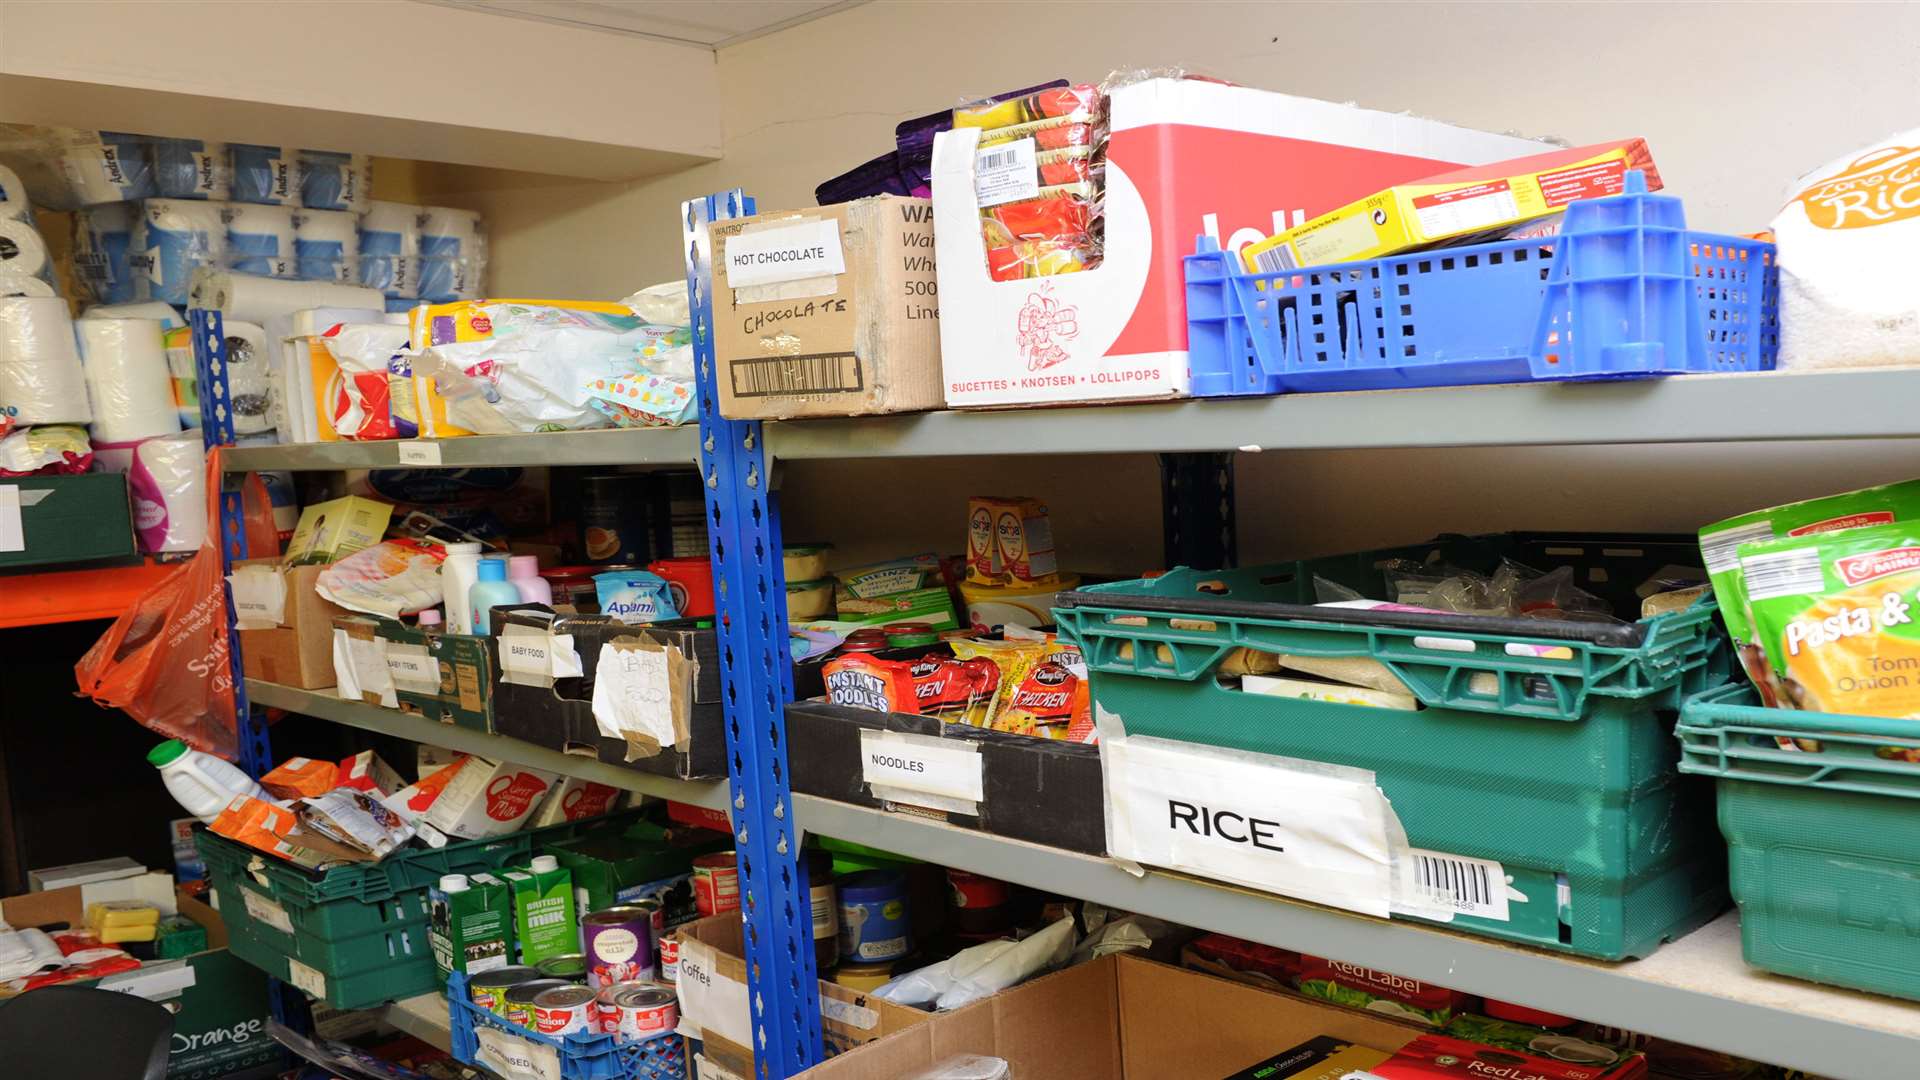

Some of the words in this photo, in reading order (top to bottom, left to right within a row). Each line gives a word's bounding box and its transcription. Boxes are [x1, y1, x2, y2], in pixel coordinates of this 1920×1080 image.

[101, 147, 124, 184] Andrex
[199, 154, 214, 191] Andrex
[274, 162, 288, 198] Andrex
[733, 253, 755, 266] HOT
[757, 246, 825, 265] CHOCOLATE
[951, 378, 1008, 393] SUCETTES
[1021, 375, 1076, 389] KNOTSEN
[1090, 368, 1161, 384] LOLLIPOPS
[1785, 606, 1873, 657] Pasta
[1880, 591, 1912, 627] &
[511, 645, 527, 657] BABY
[528, 648, 545, 659] FOOD
[402, 662, 418, 671] ITEMS
[827, 670, 886, 695] INSTANT
[1837, 671, 1909, 693] Onion
[1013, 690, 1069, 707] CHICKEN
[871, 754, 925, 774] NOODLES
[1168, 799, 1285, 853] RICE
[681, 958, 711, 987] Coffee
[1368, 968, 1420, 994] Label
[1467, 1059, 1512, 1078] Red
